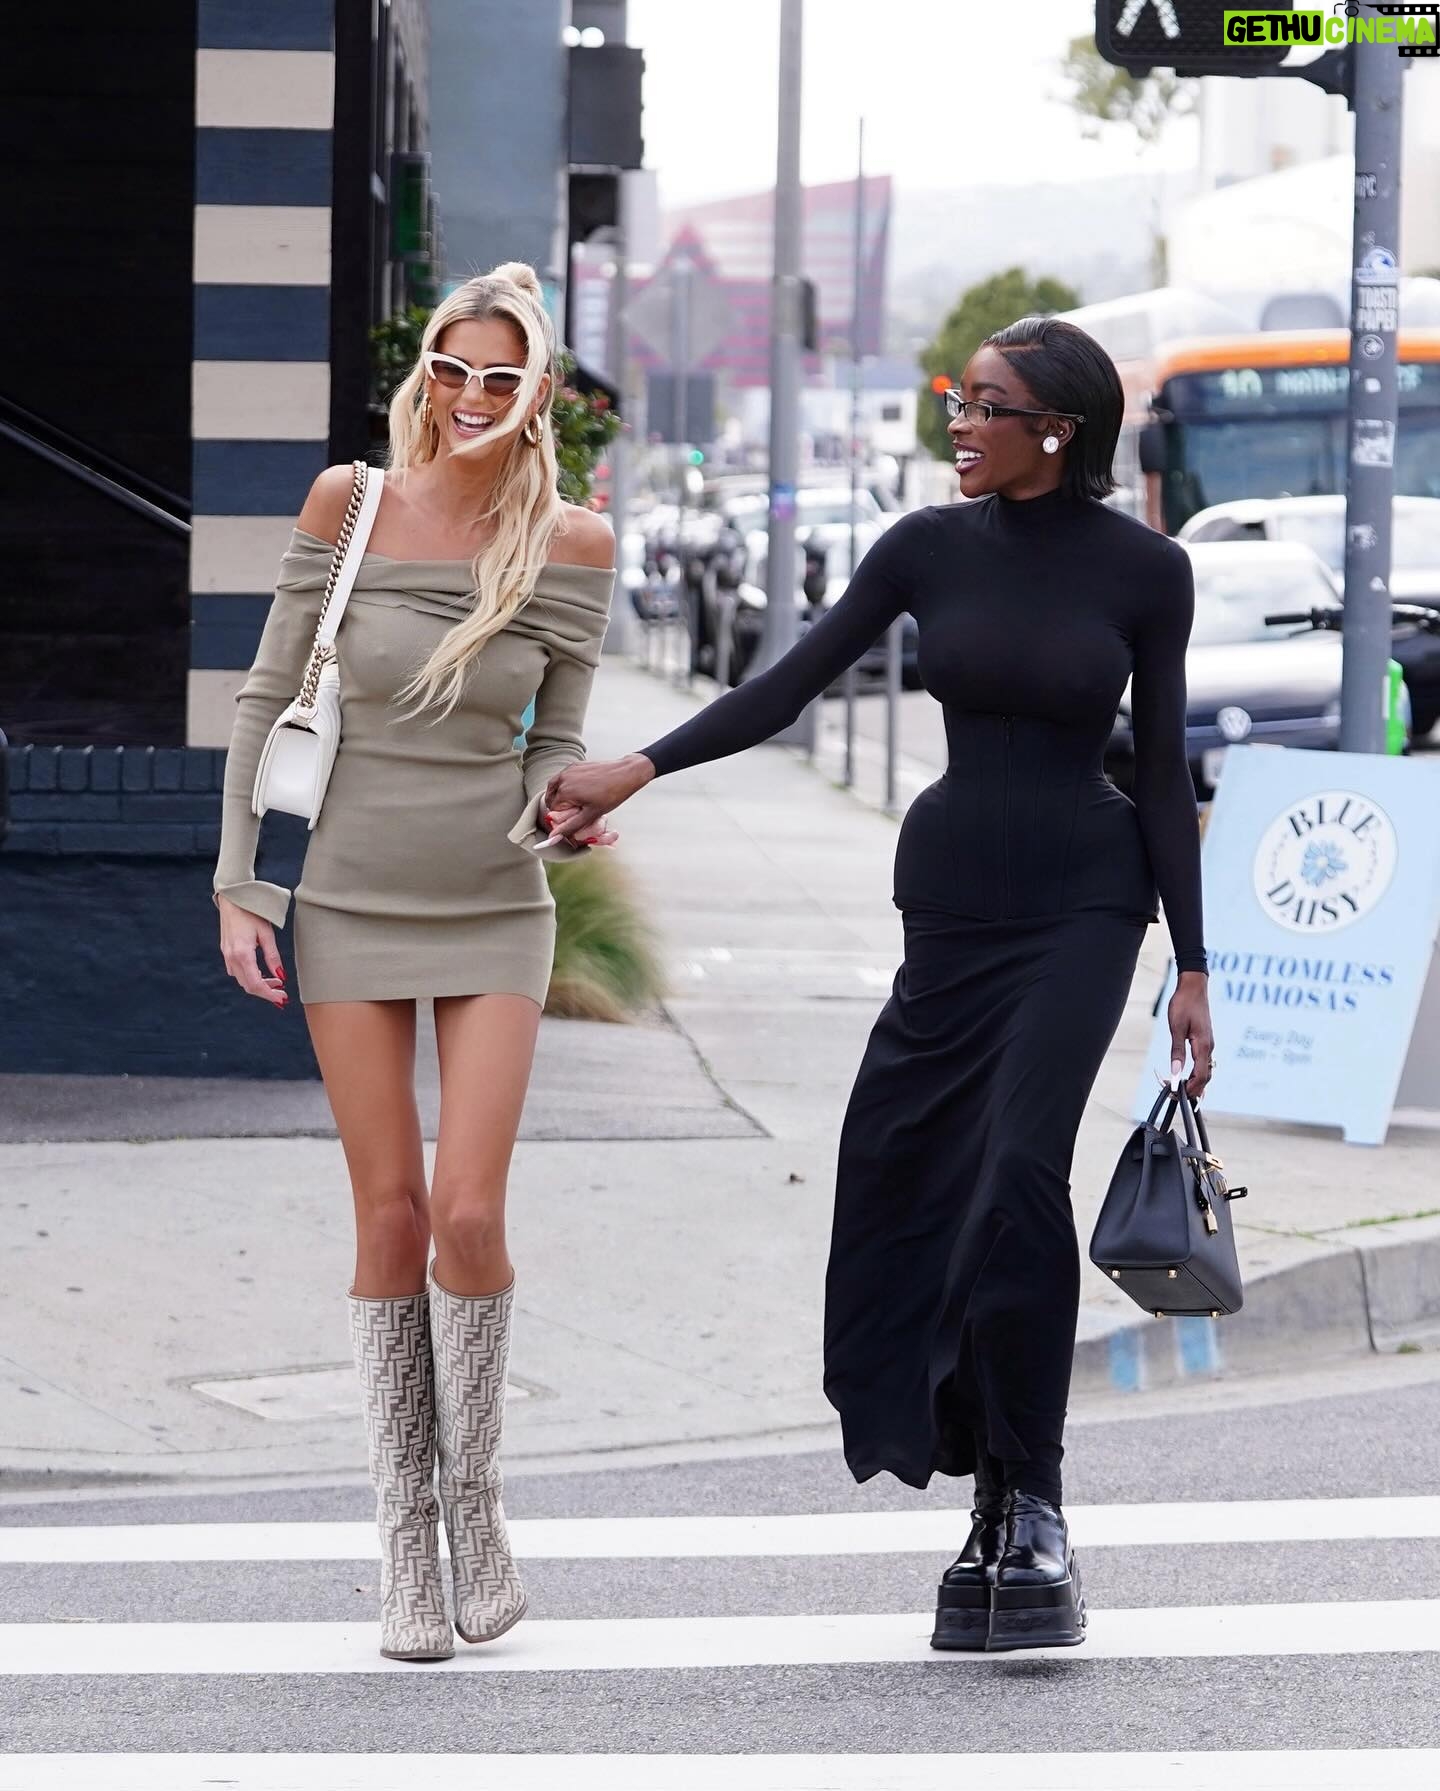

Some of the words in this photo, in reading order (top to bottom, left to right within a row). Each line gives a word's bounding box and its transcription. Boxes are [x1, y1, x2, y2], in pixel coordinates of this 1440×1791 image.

[1288, 798, 1383, 843] BLUE
[1266, 878, 1361, 925] DAISY
[1206, 950, 1396, 985] BOTTOMLESS
[1224, 979, 1359, 1012] MIMOSAS
